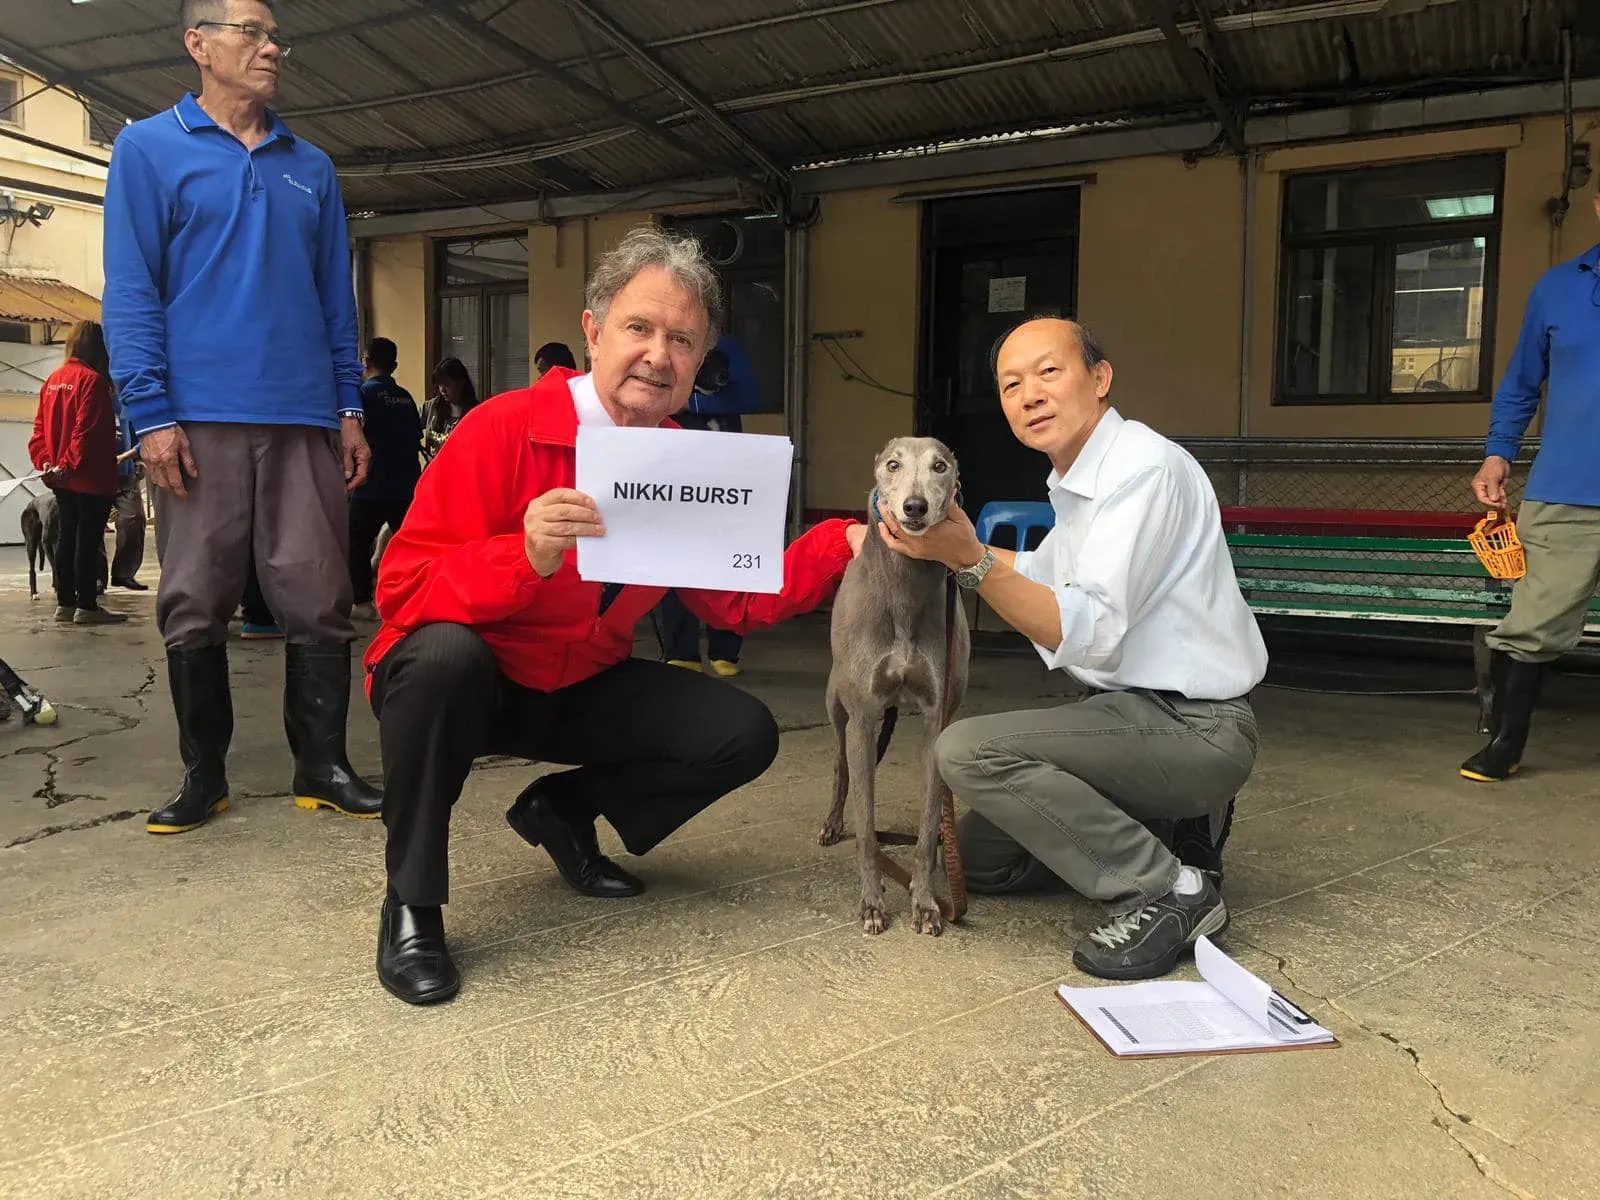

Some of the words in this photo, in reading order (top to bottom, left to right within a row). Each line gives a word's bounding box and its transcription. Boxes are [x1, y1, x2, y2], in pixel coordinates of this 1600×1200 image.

[614, 482, 672, 501] NIKKI
[680, 486, 752, 505] BURST
[733, 554, 760, 568] 231
